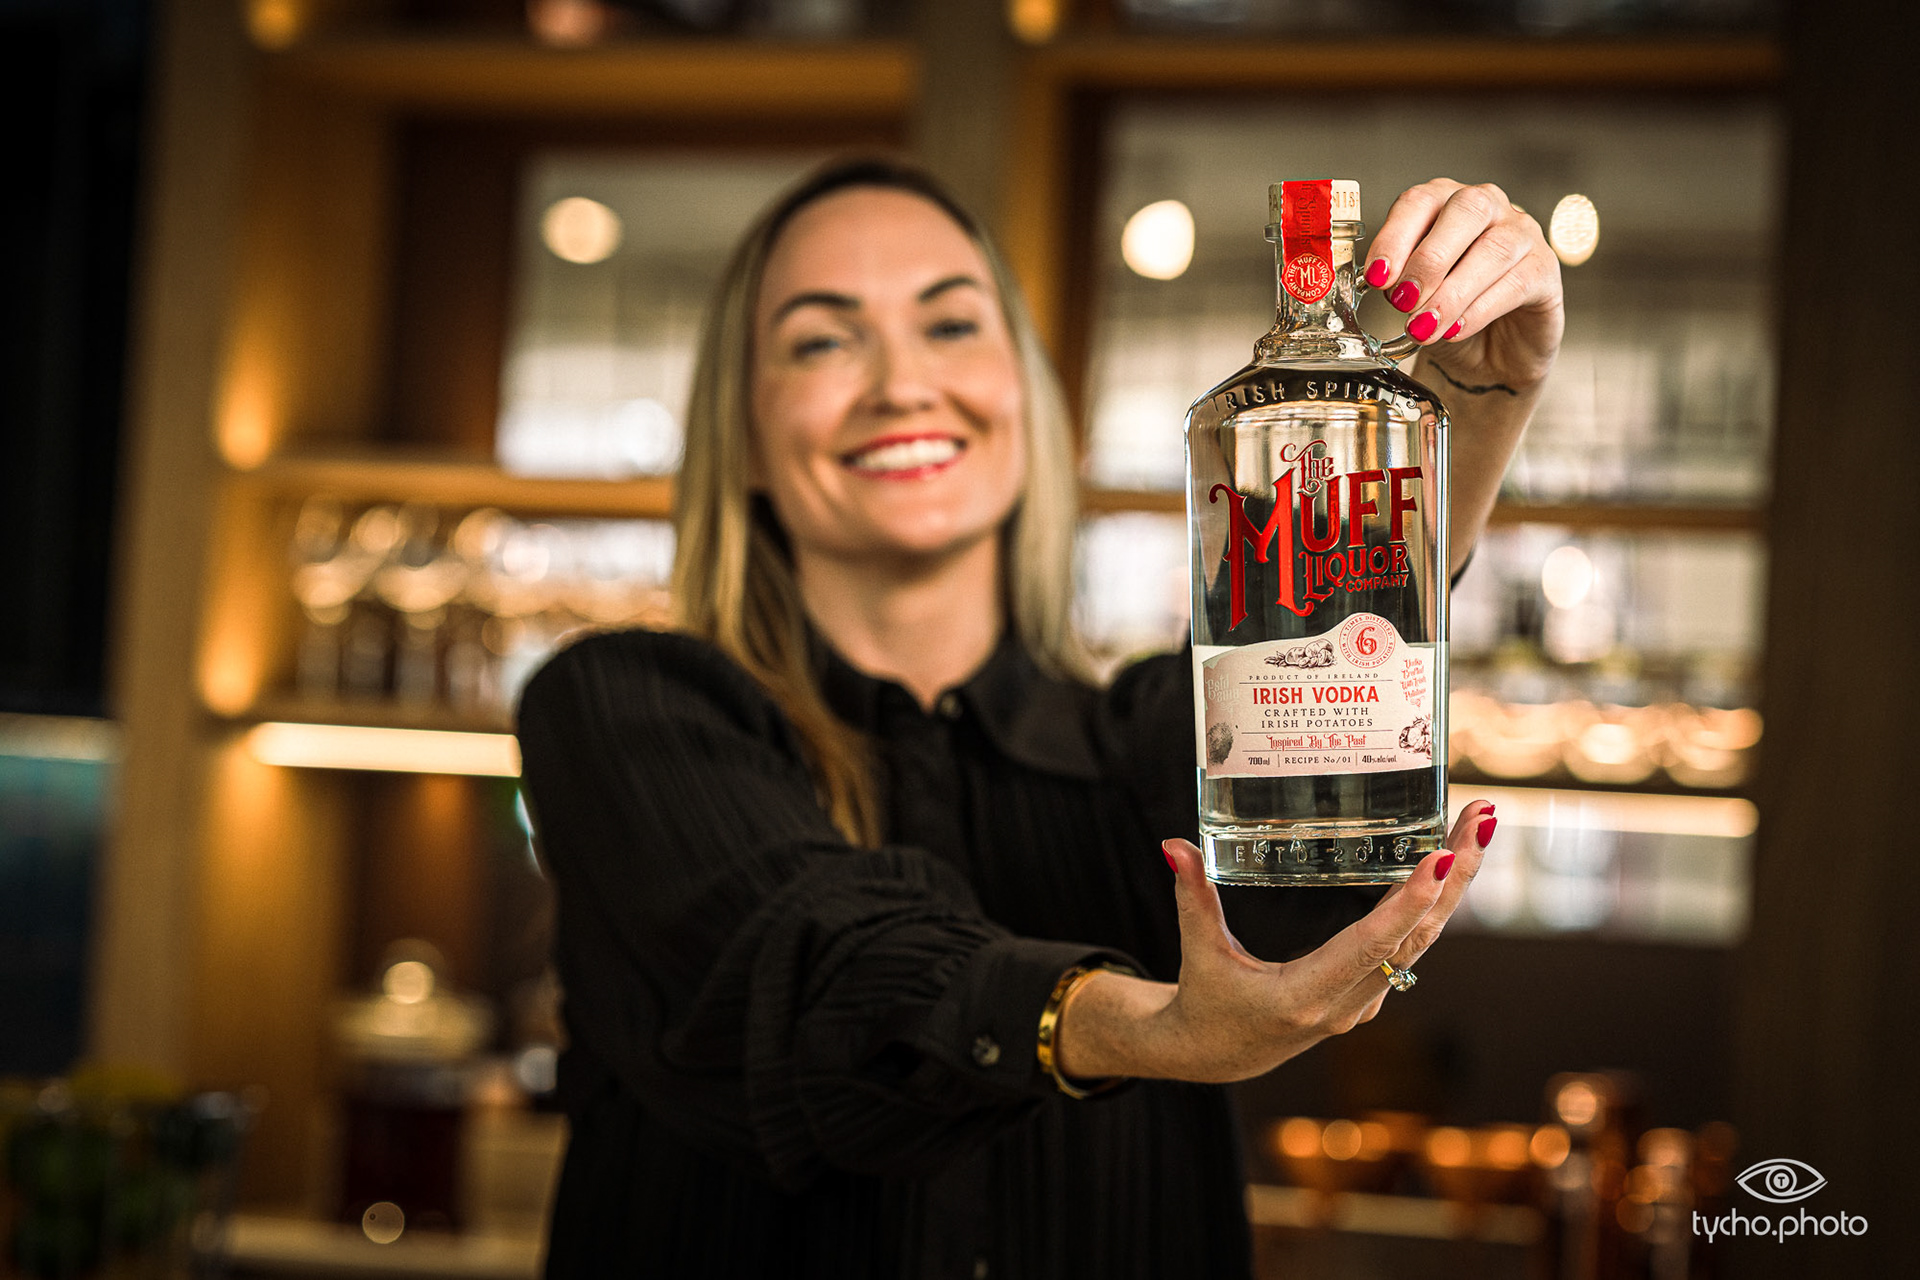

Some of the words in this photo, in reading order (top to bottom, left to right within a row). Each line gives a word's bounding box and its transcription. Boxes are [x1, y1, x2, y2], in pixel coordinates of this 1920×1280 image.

[1288, 263, 1298, 278] THE
[1297, 257, 1318, 266] MUFF
[1316, 261, 1328, 289] LIQUOR
[1289, 281, 1321, 298] COMPANY
[1211, 381, 1286, 412] IRISH
[1280, 439, 1334, 494] The
[1208, 465, 1424, 632] MUFF
[1298, 544, 1410, 602] LIQUOR
[1345, 573, 1409, 593] COMPANY
[1355, 626, 1377, 655] 6
[1253, 687, 1303, 704] IRISH
[1312, 685, 1380, 704] VODKA
[1264, 708, 1327, 717] CRAFTED
[1333, 707, 1369, 716] WITH
[1261, 720, 1299, 729] IRISH
[1306, 718, 1373, 728] POTATOES
[1266, 735, 1303, 751] Inspired
[1307, 735, 1322, 749] By
[1323, 733, 1342, 749] The
[1344, 733, 1367, 749] Past
[1284, 756, 1320, 764] RECIPE
